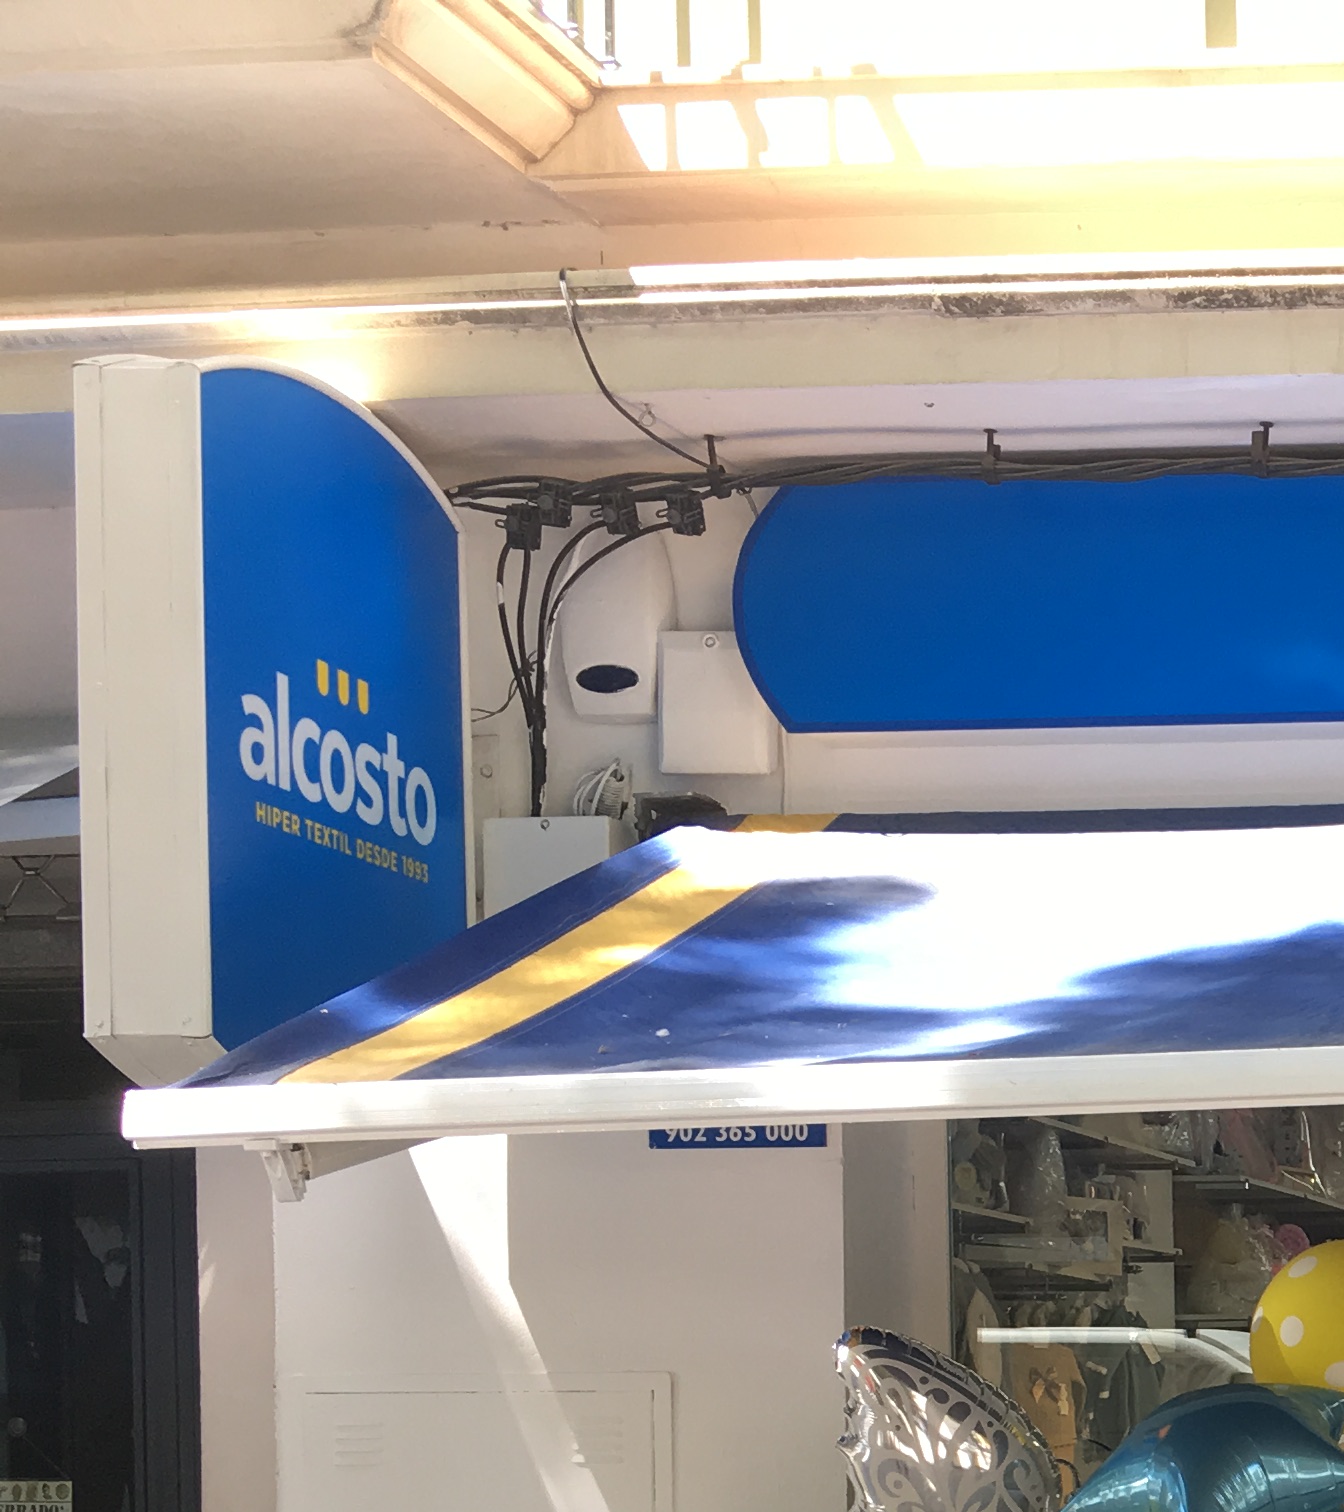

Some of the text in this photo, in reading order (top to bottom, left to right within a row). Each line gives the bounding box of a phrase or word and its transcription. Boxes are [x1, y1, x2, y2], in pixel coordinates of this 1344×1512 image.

[239, 671, 436, 846] alcosto
[256, 801, 429, 883] HIPER TEXTIL DESDE 1993
[665, 1124, 808, 1142] 902 365 000
